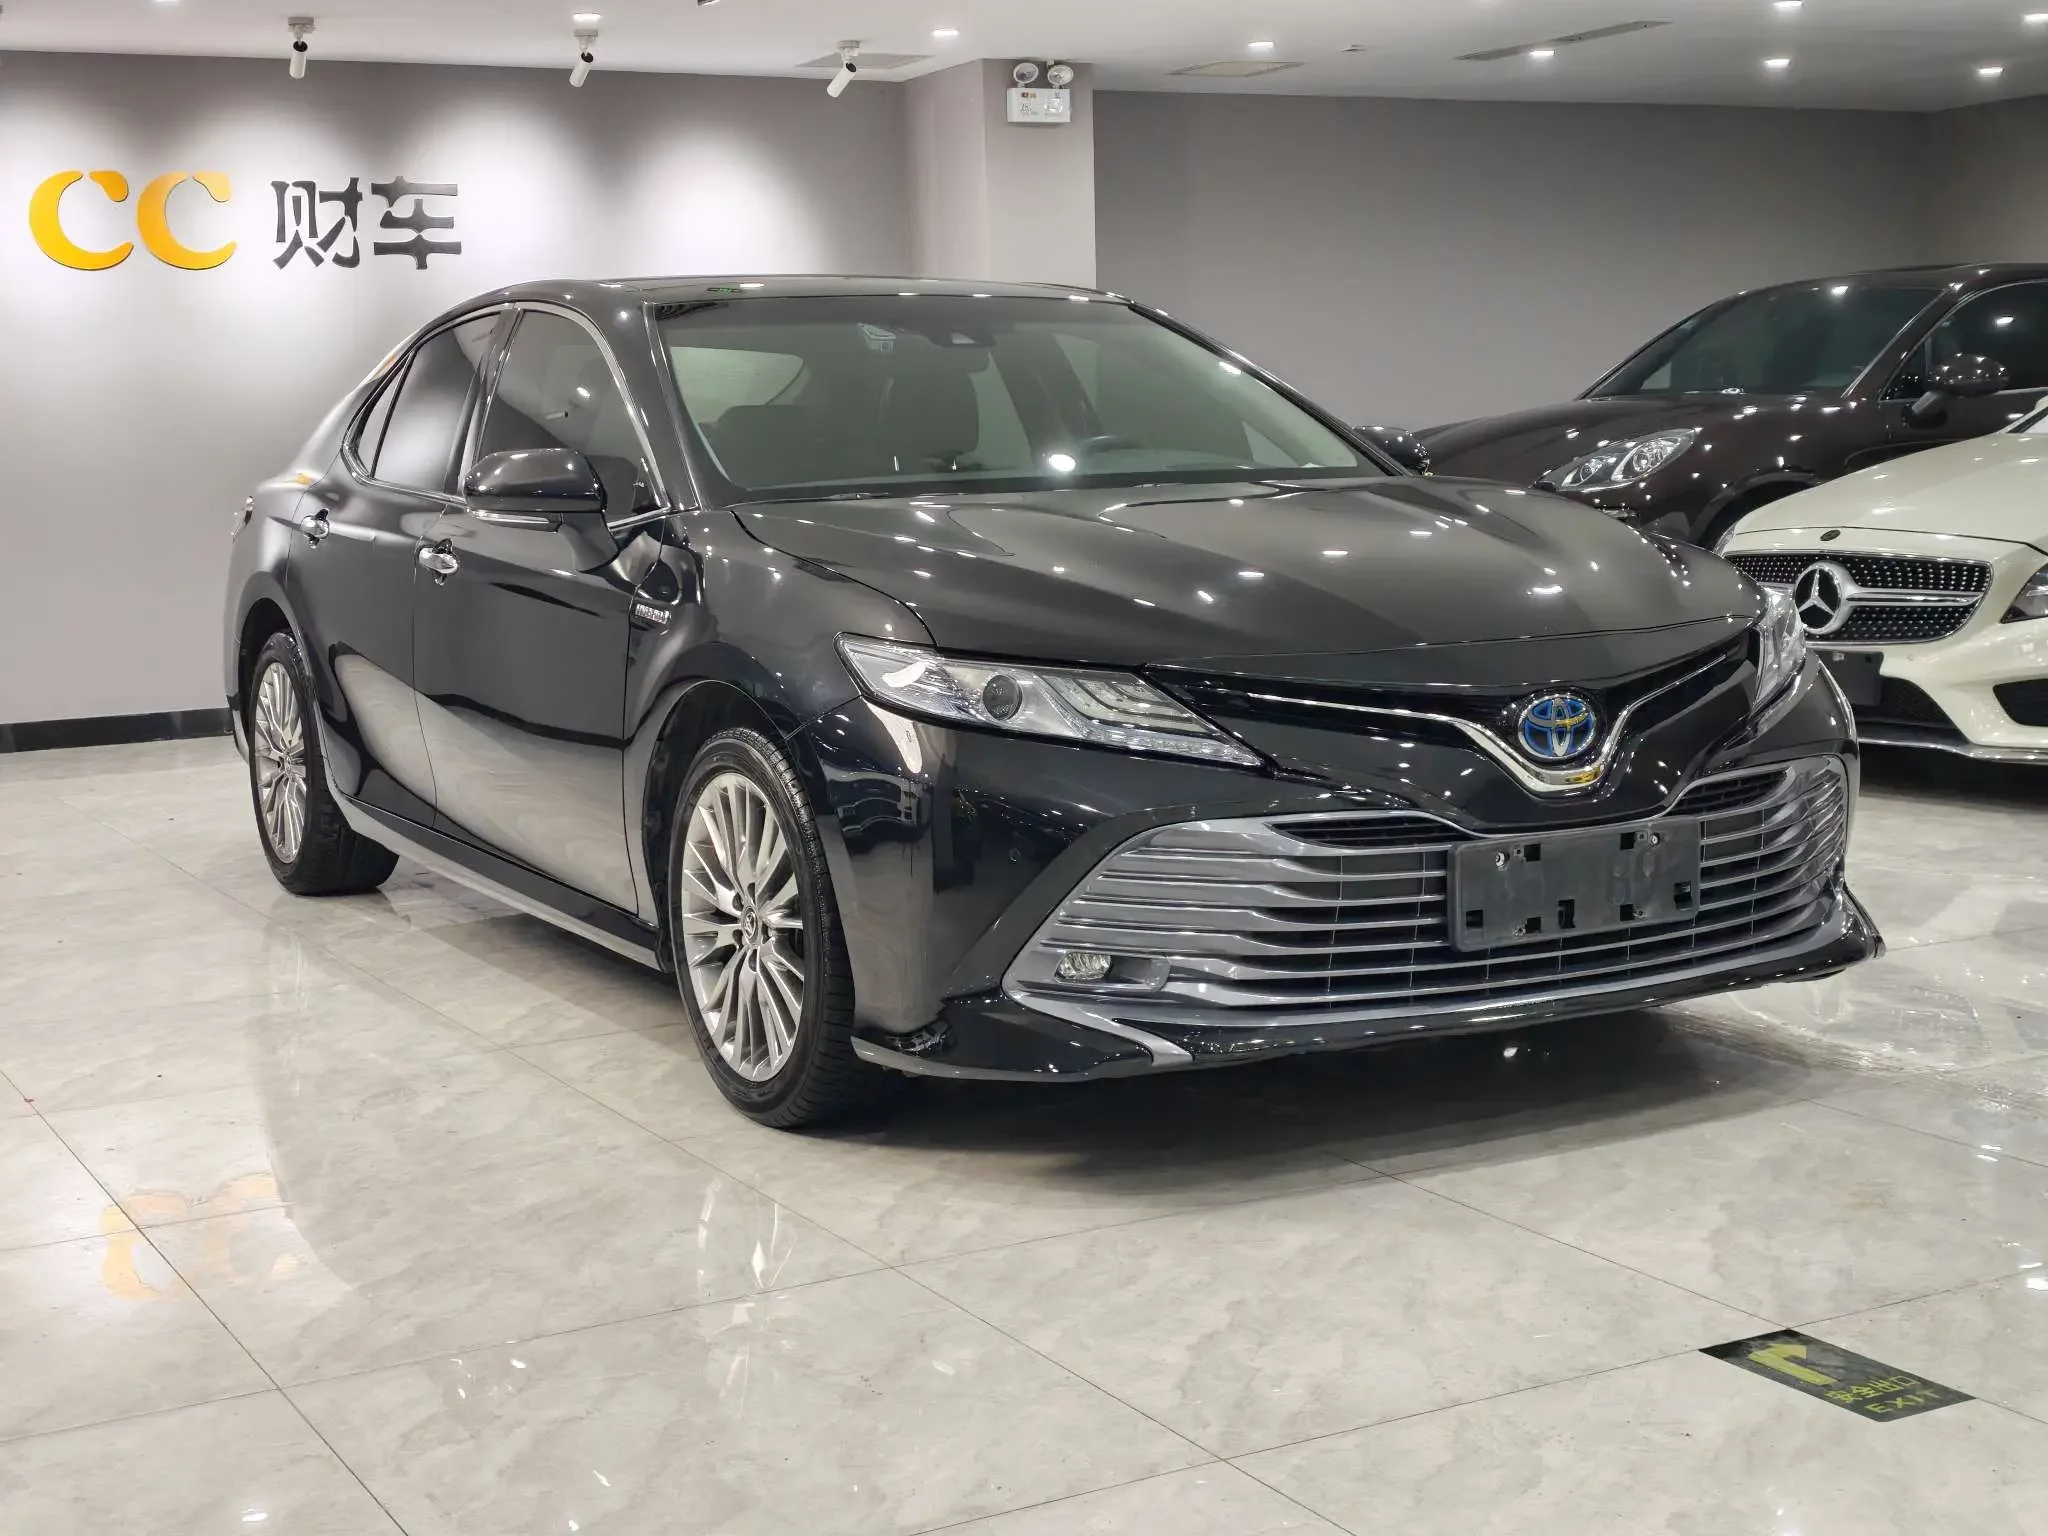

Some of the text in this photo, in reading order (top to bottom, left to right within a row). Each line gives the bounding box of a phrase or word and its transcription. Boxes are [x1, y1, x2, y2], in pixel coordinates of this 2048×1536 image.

[28, 170, 462, 271] CC 财车
[1825, 1376, 1919, 1403] 安全出口
[1865, 1389, 1940, 1413] EXIT
